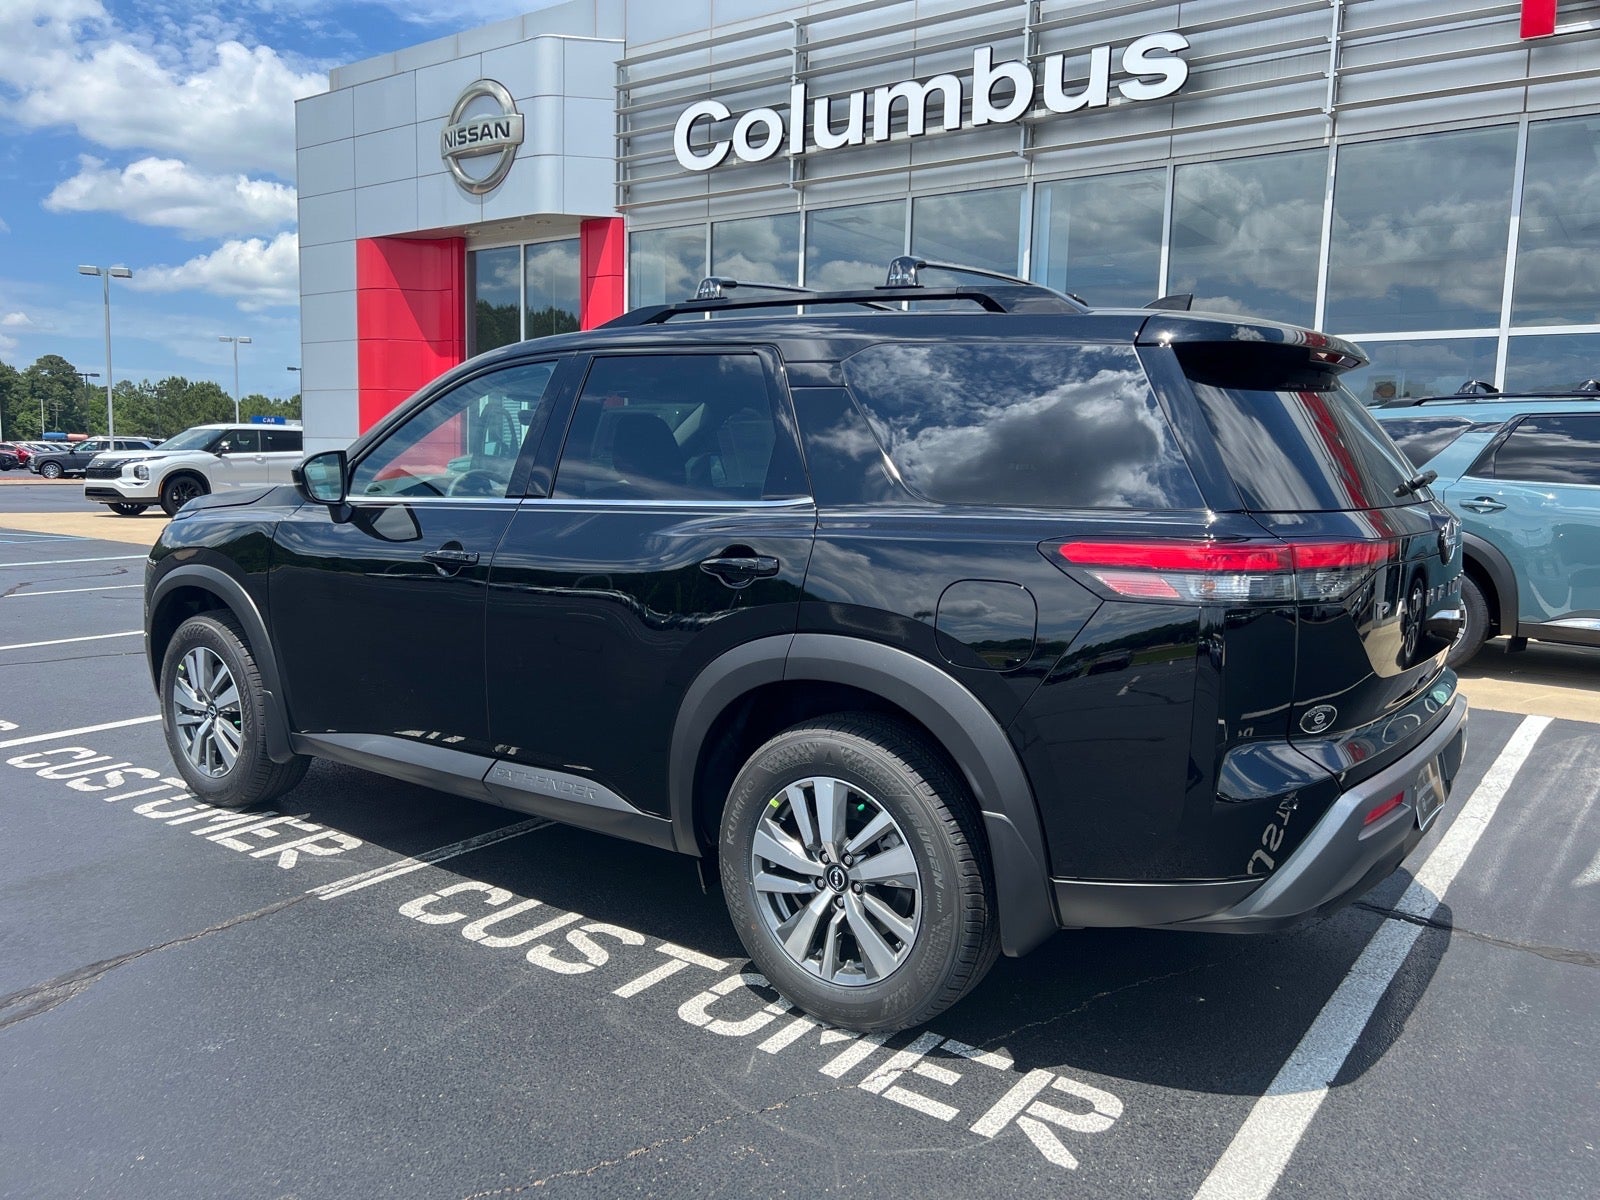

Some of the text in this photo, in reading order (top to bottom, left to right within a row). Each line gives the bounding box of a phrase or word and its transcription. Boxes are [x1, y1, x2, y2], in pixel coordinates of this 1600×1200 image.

[443, 121, 511, 150] NISSAN
[673, 30, 1191, 172] Columbus
[5, 746, 363, 870] CUSTOMER
[493, 766, 598, 800] PATHFINDER
[399, 880, 1125, 1170] CUSTOMER
